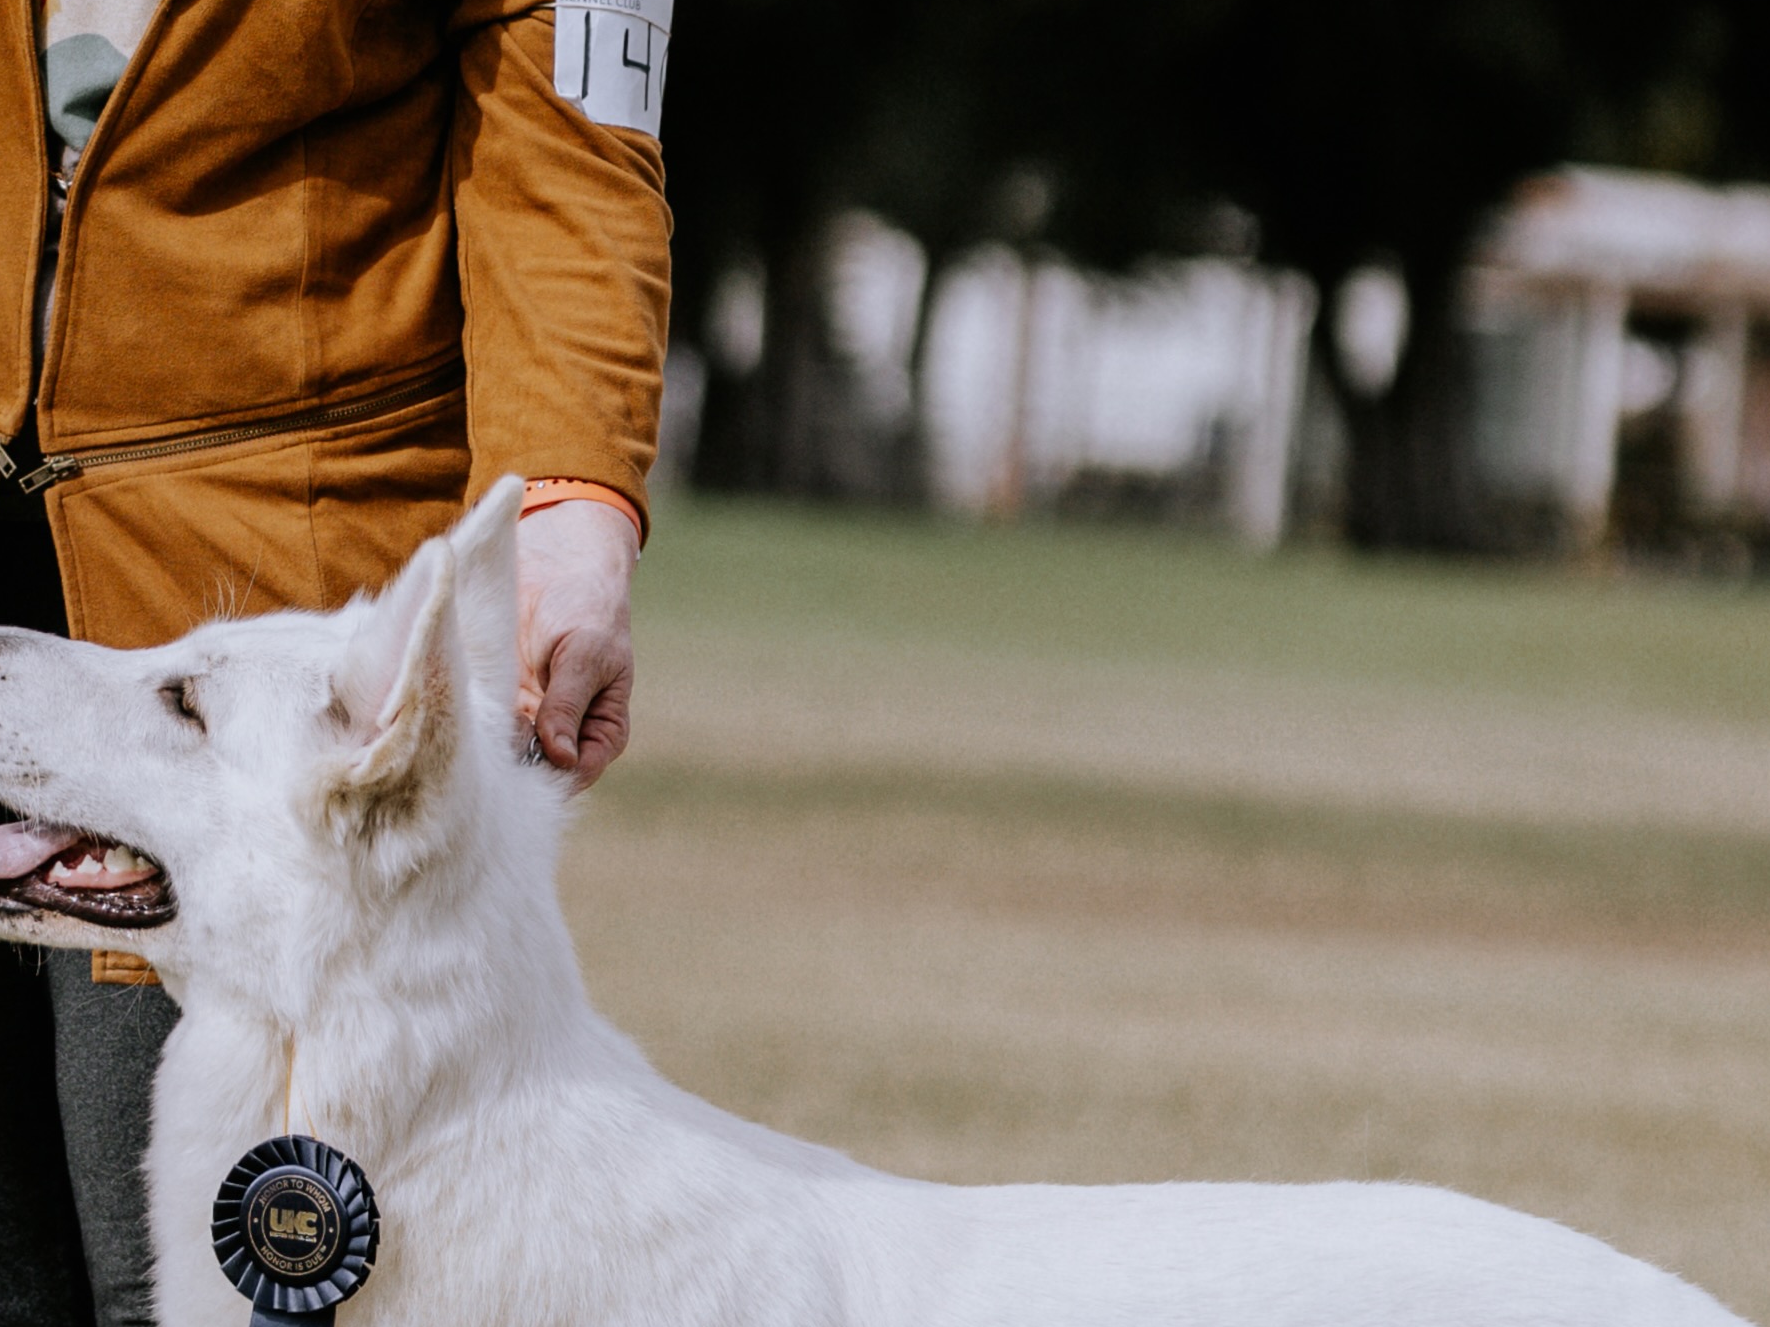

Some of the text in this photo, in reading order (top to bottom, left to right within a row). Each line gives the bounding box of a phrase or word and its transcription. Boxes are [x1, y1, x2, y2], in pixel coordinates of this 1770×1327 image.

[581, 10, 652, 112] 14
[258, 1178, 332, 1213] HONOR TO WHOM
[269, 1207, 318, 1236] UKC
[260, 1245, 293, 1271] HONOR
[295, 1262, 304, 1271] IS
